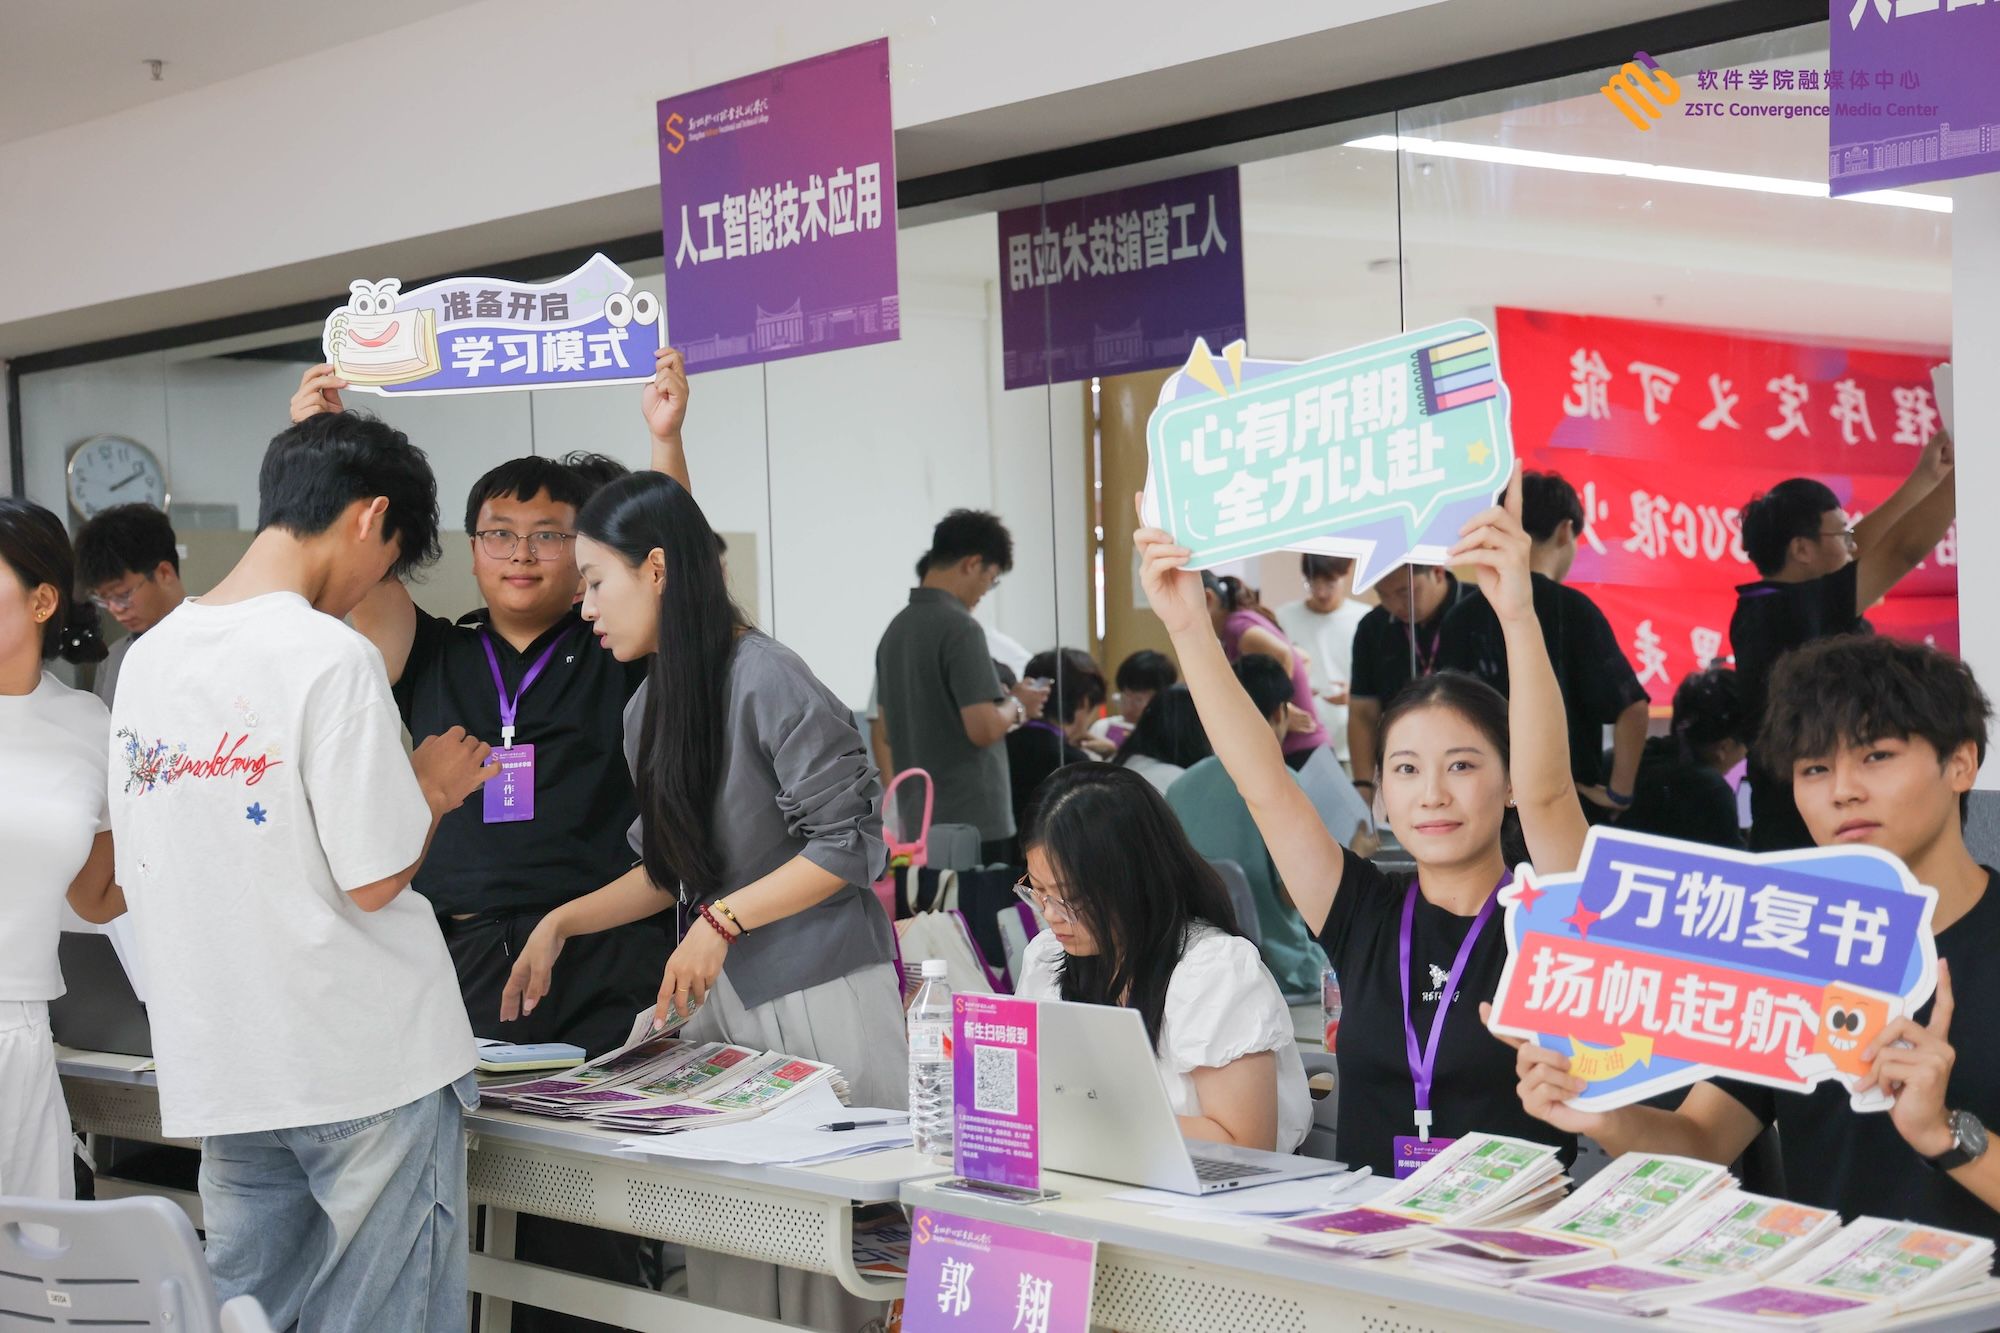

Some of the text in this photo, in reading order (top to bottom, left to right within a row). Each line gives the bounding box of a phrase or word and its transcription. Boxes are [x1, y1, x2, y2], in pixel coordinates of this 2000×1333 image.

[675, 162, 882, 269] 人工智能技术应用
[441, 290, 570, 322] 准备开启
[451, 327, 631, 377] 学习模式
[1180, 362, 1408, 476] 心有所期
[1213, 421, 1446, 536] 全力以赴
[504, 772, 515, 807] 工作证
[1600, 860, 1891, 967] 万物复书
[963, 1020, 1028, 1046] 新生扫码报到
[1523, 945, 1813, 1063] 扬帆起航
[1578, 1051, 1625, 1076] 加油
